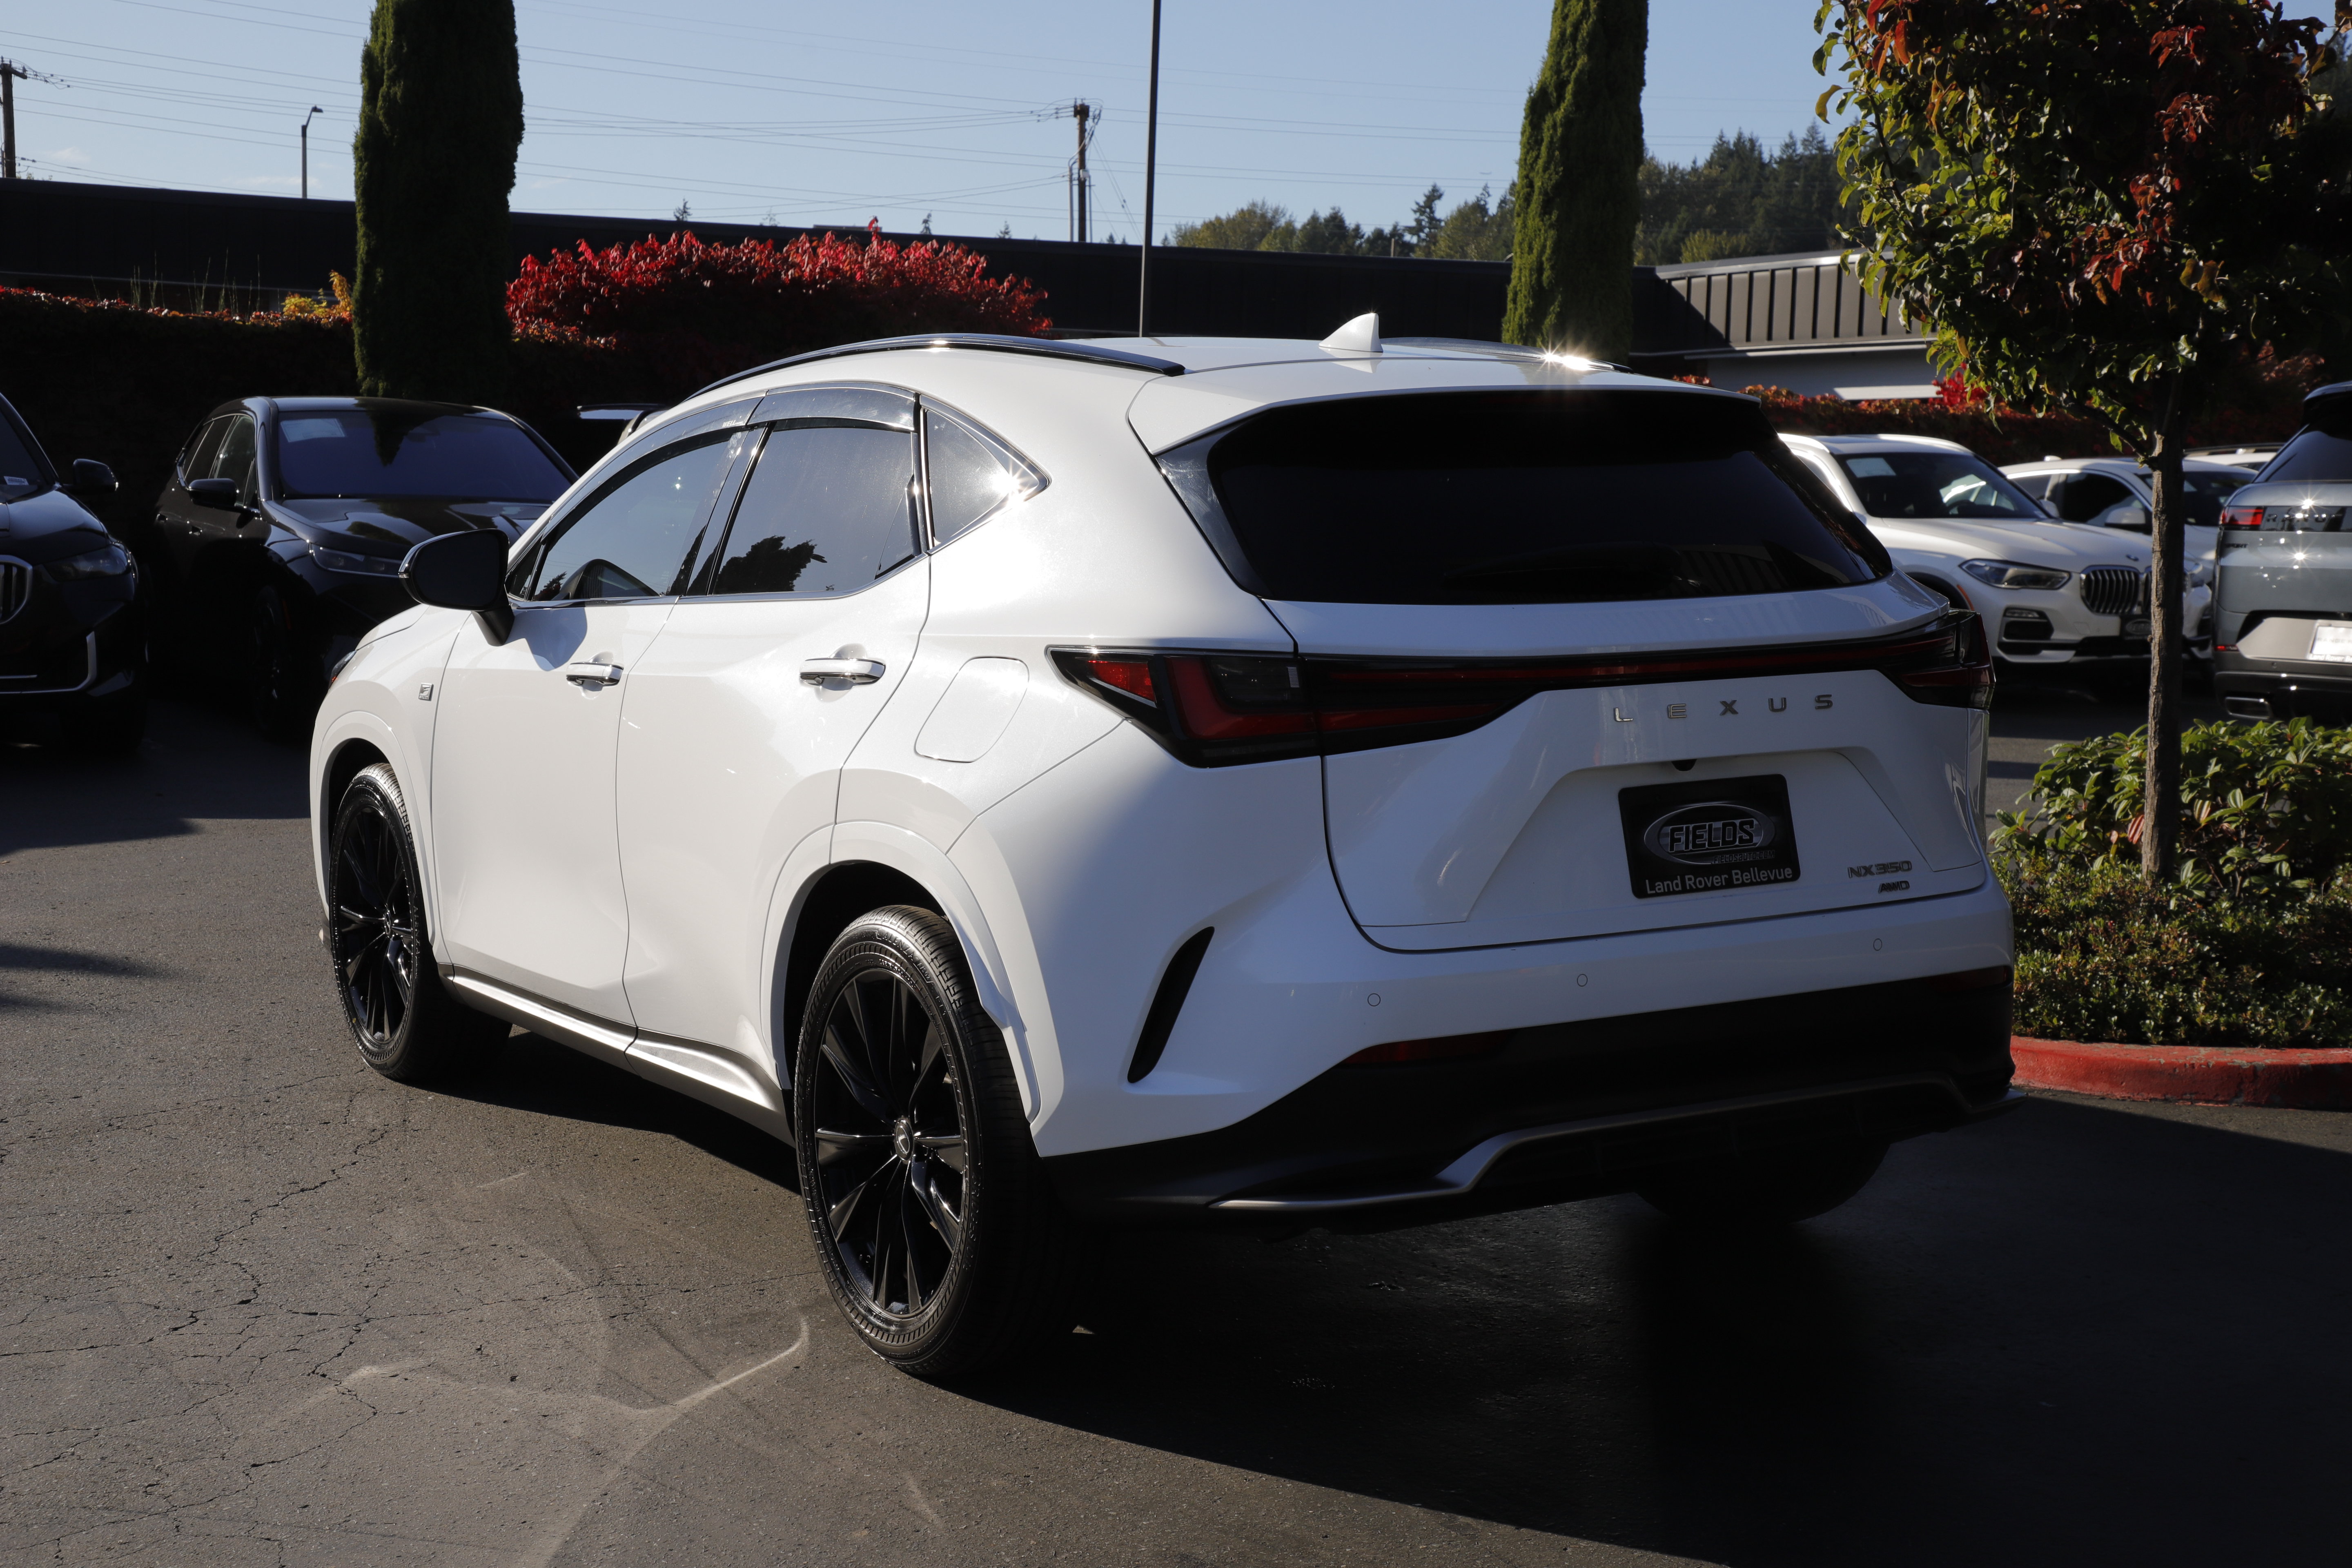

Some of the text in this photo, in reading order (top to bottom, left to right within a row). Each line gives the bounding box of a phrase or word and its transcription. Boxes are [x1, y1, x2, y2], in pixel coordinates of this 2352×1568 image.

[1613, 694, 1834, 722] LEXUS
[1668, 818, 1755, 853] FIELDS
[1646, 867, 1793, 894] Land Rover Bellevue
[1878, 880, 1910, 894] AWD
